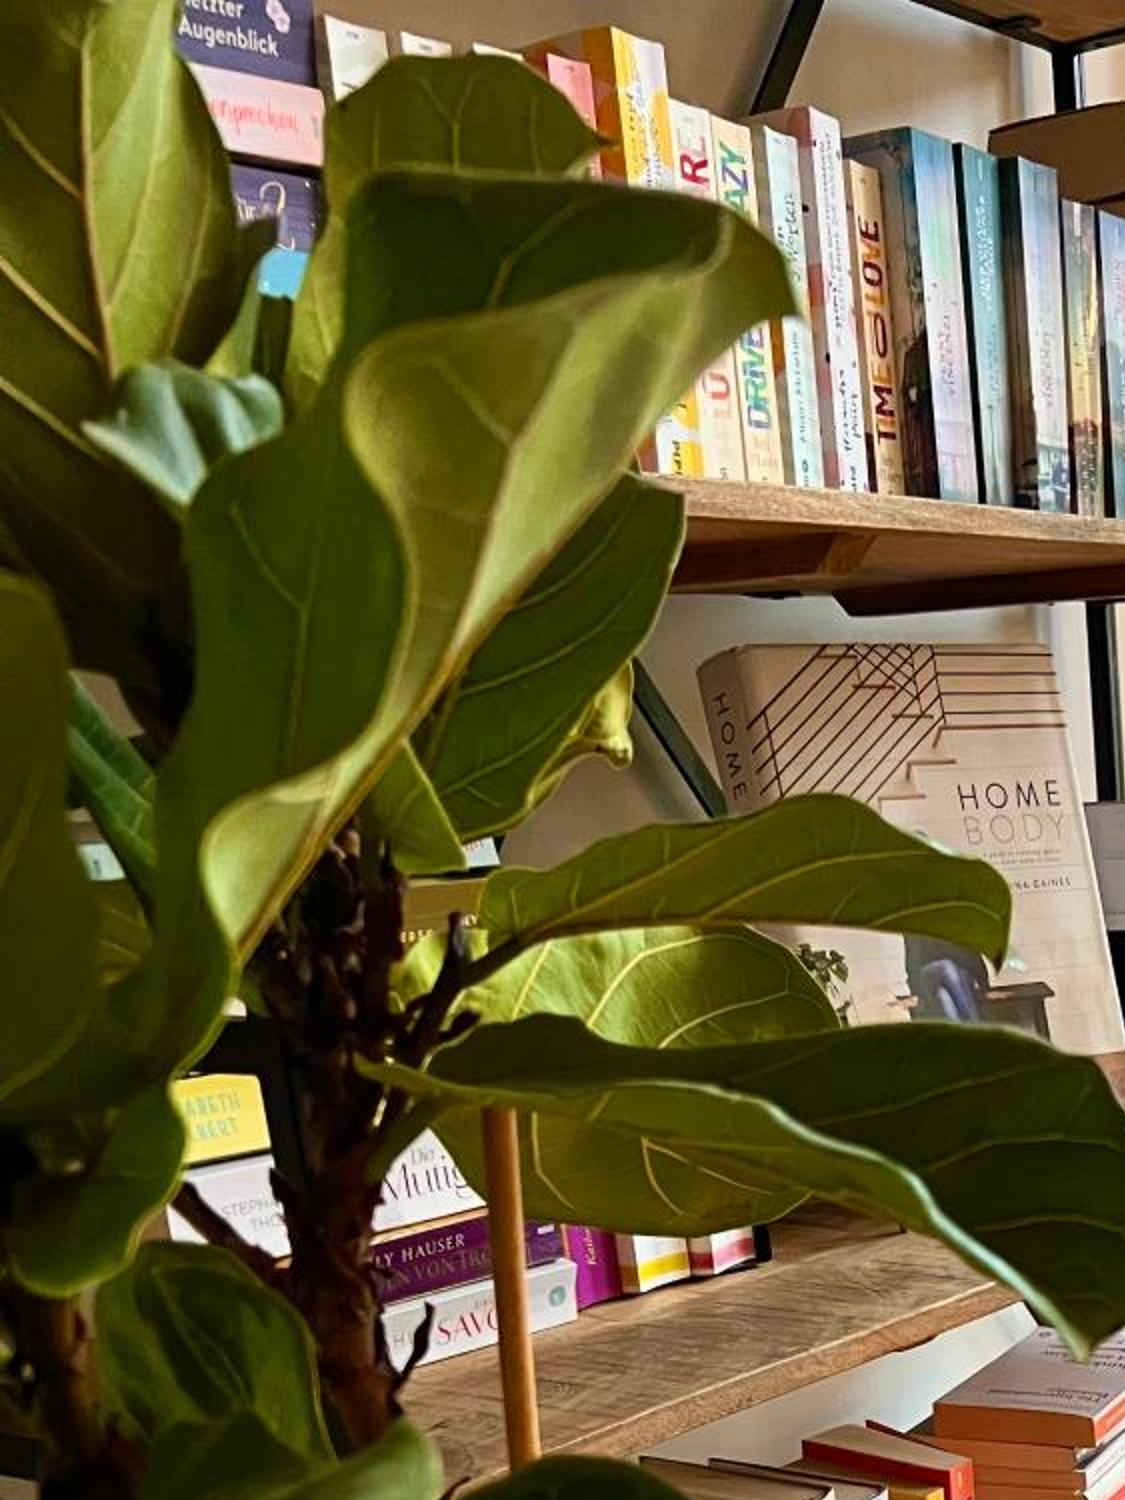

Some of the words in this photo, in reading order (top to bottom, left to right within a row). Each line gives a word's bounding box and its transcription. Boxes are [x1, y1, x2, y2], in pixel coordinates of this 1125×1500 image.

[186, 0, 244, 17] etzter
[178, 14, 279, 57] Augenblick
[717, 140, 750, 215] AZY
[857, 215, 885, 309] LOVE
[872, 360, 897, 446] TIME
[712, 690, 748, 801] HOME
[956, 779, 1062, 811] HOME
[962, 811, 1064, 846] BODY
[185, 1091, 241, 1117] ABETH
[374, 1251, 394, 1271] LY
[401, 1233, 465, 1264] HAUSER
